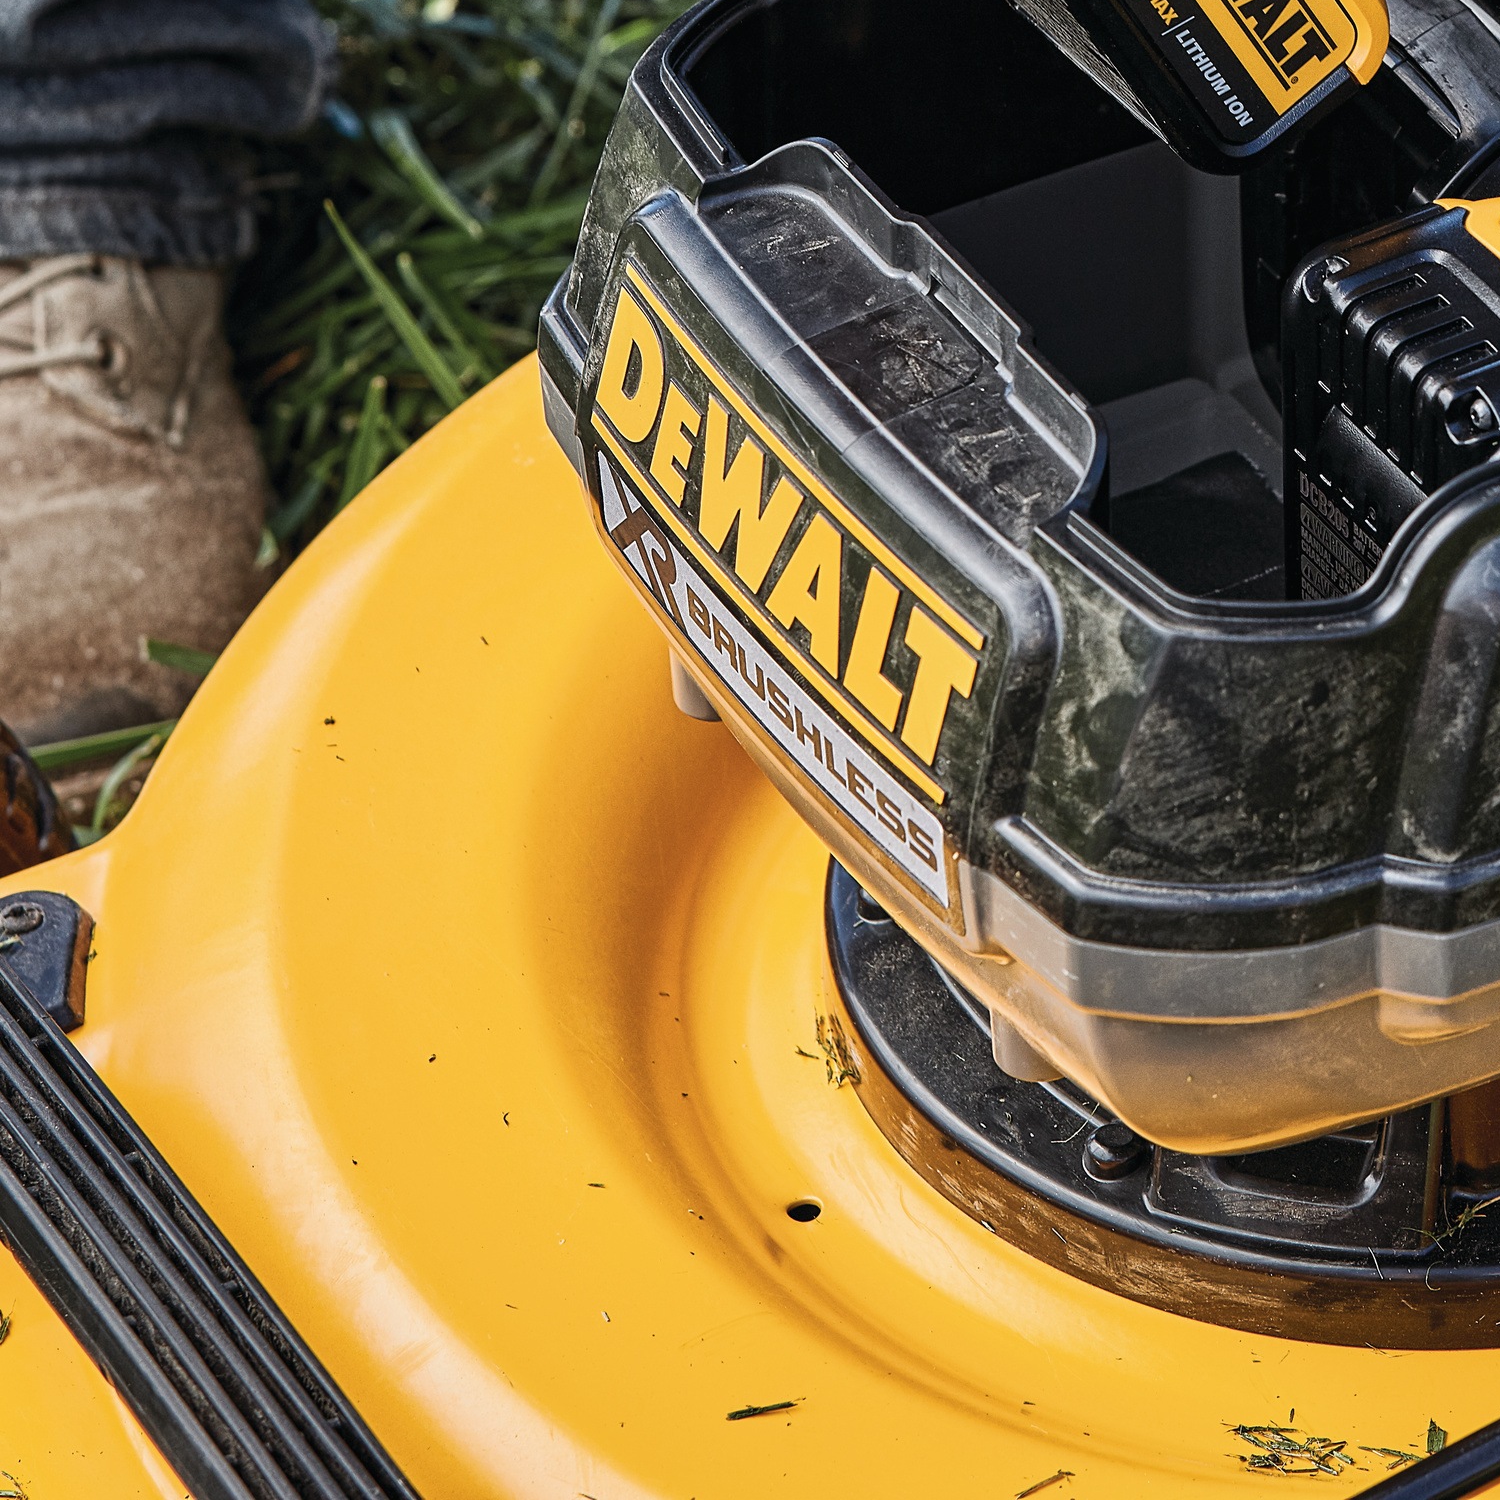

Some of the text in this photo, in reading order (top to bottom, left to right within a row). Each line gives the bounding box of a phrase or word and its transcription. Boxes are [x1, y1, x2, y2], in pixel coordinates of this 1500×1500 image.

[1175, 29, 1232, 97] LITHIUM
[1223, 94, 1254, 128] ION
[594, 283, 980, 766] DEWALT
[1299, 470, 1349, 538] DCB205
[1311, 515, 1363, 581] WARNING
[609, 462, 938, 872] XR BRUSHLESS
